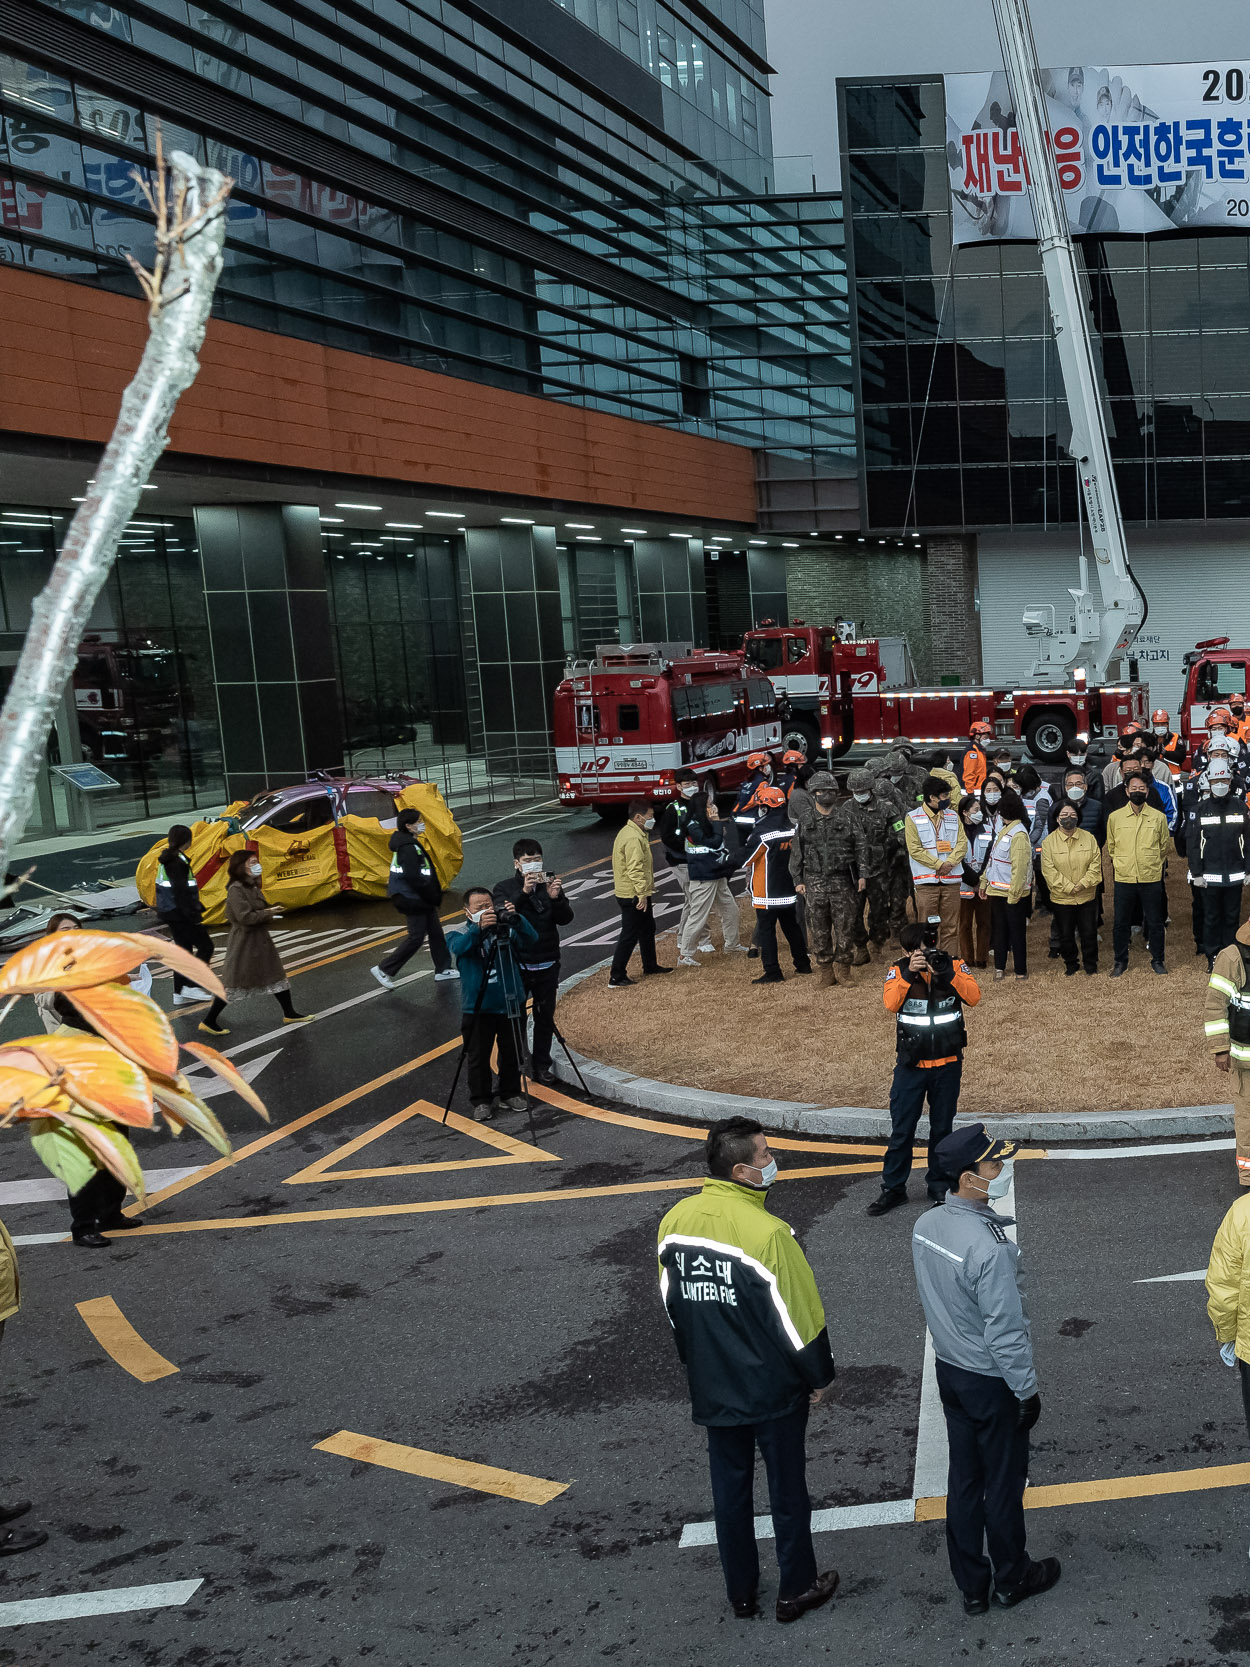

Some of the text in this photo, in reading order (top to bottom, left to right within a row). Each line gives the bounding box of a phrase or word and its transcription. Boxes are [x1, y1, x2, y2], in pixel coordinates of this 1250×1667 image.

[962, 127, 1082, 194] 재난응
[1139, 650, 1170, 661] 차고지
[581, 756, 611, 772] 119
